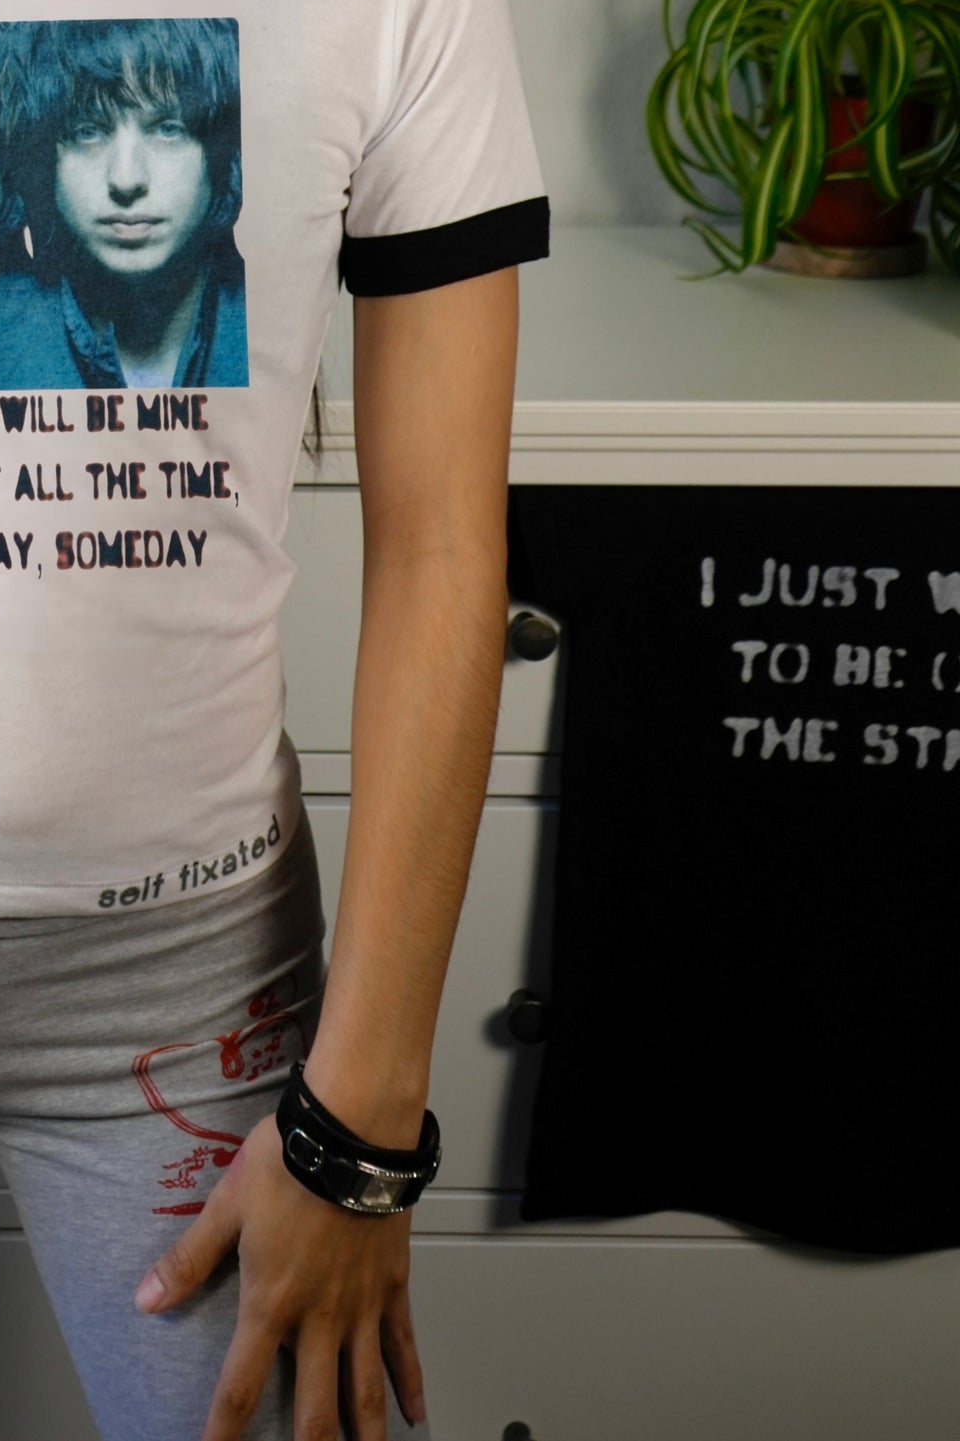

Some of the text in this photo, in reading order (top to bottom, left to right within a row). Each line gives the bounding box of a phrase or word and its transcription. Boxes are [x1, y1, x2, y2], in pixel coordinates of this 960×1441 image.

[86, 394, 125, 433] BE
[136, 393, 209, 432] MINE
[14, 462, 74, 502] ALL
[85, 461, 147, 500] THE
[158, 460, 240, 509] TIME,
[55, 529, 208, 570] SOMEDAY
[701, 556, 715, 608] I
[738, 557, 901, 611] JUST
[731, 639, 810, 684] TO
[722, 716, 839, 763] THE
[98, 813, 282, 908] self fixated
